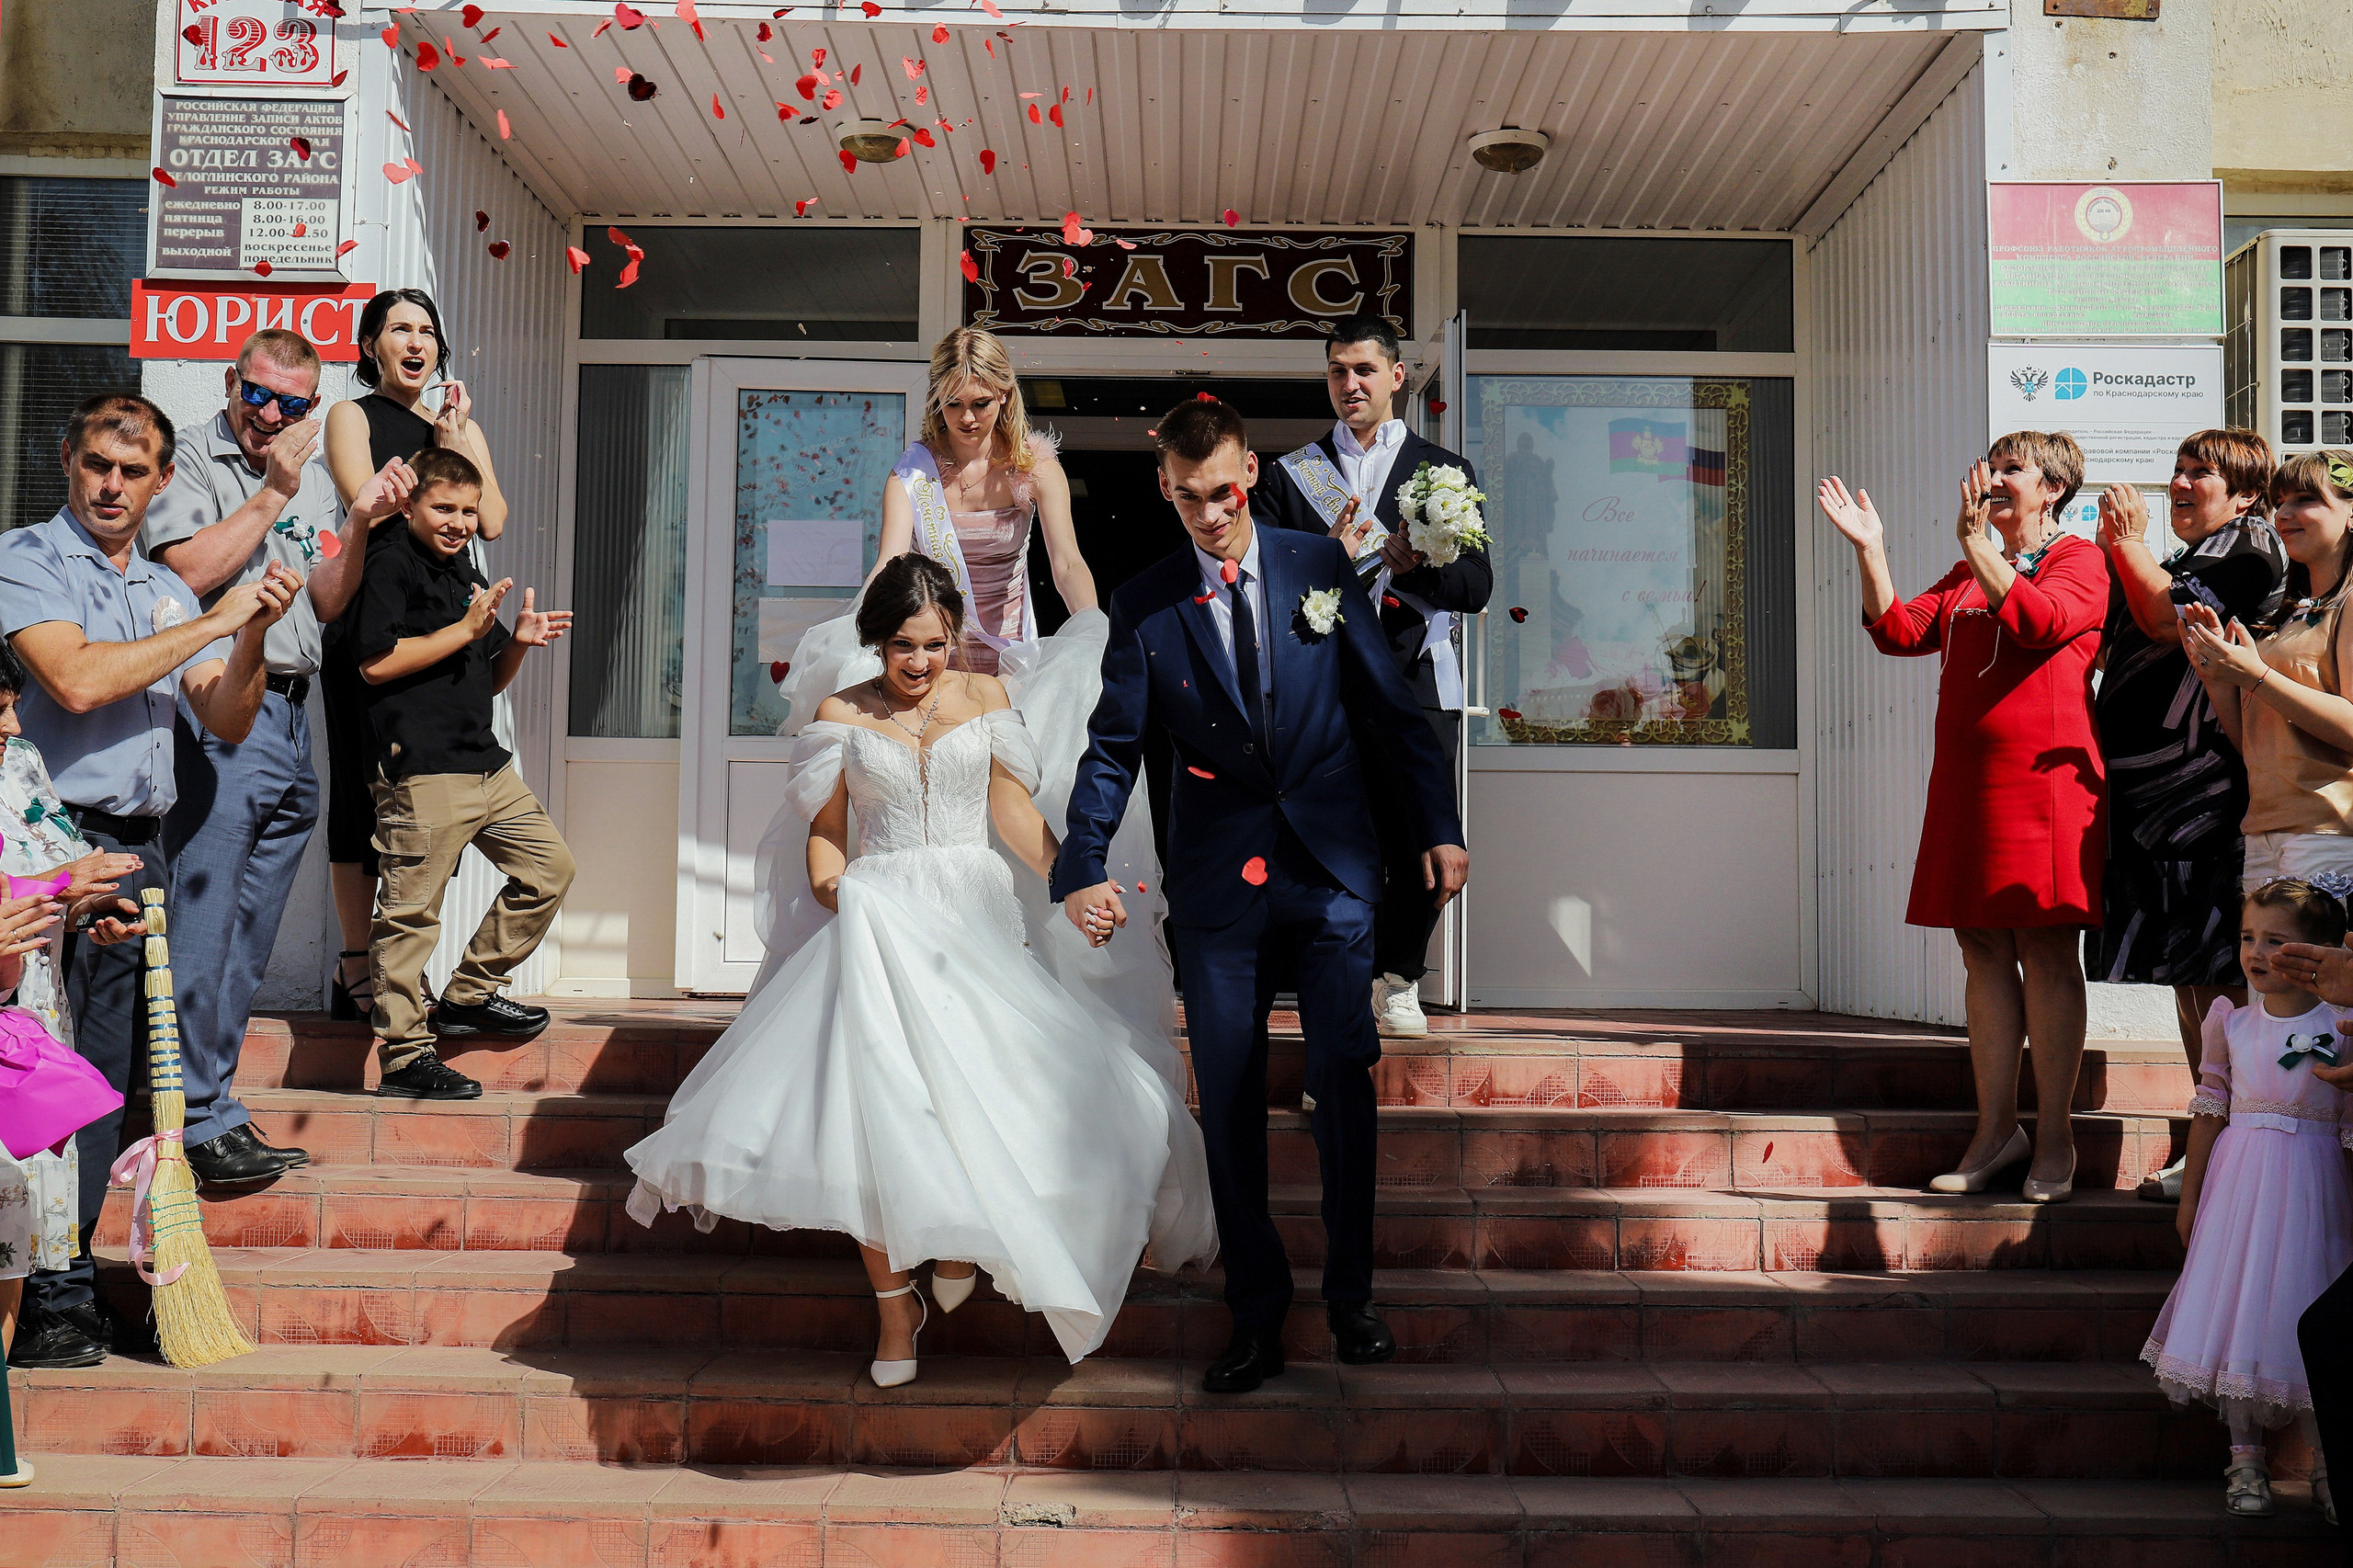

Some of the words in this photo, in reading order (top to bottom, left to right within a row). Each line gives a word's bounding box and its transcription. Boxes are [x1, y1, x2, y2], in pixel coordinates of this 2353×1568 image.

[194, 15, 319, 74] 123
[176, 101, 257, 111] РОССИЙСКАЯ
[261, 103, 335, 114] ФЕДЕРАЦИЯ
[166, 112, 246, 122] УПРАВЛЕНИЕ
[250, 114, 300, 123] ЗАПИСИ
[303, 115, 343, 124] АКТОВ
[166, 123, 266, 134] ГРАЖДАНСКОГО
[269, 125, 343, 135] СОСТОЯНИЯ
[178, 135, 290, 146] КРАСНОДАРСКОГО
[169, 148, 257, 171] ОТДЕЛ
[267, 150, 337, 169] ЗАГС
[283, 172, 339, 184] РАЙОНА
[204, 186, 247, 195] РЕЖИМ
[252, 186, 300, 195] РАБОТЫ
[165, 200, 241, 210] ежедневно
[254, 200, 325, 210] 8.00-17.00
[164, 214, 222, 225] пятница
[253, 214, 325, 224] 8.00-16.00
[164, 228, 224, 239] перерыв
[162, 246, 232, 257] выходной
[244, 244, 332, 253] воскресенье
[244, 256, 333, 264] понедельник
[1012, 248, 1365, 315] ЗАГС
[143, 295, 368, 346] ЮРИСТ
[2093, 371, 2196, 389] Роскадастр
[2106, 389, 2179, 399] Краснодарскому
[2181, 391, 2204, 399] краю
[1582, 496, 1635, 523] Все
[913, 477, 944, 560] Почетная
[1567, 547, 1678, 562] начинается
[1620, 590, 1631, 603] с
[1638, 580, 1707, 604] семьи!
